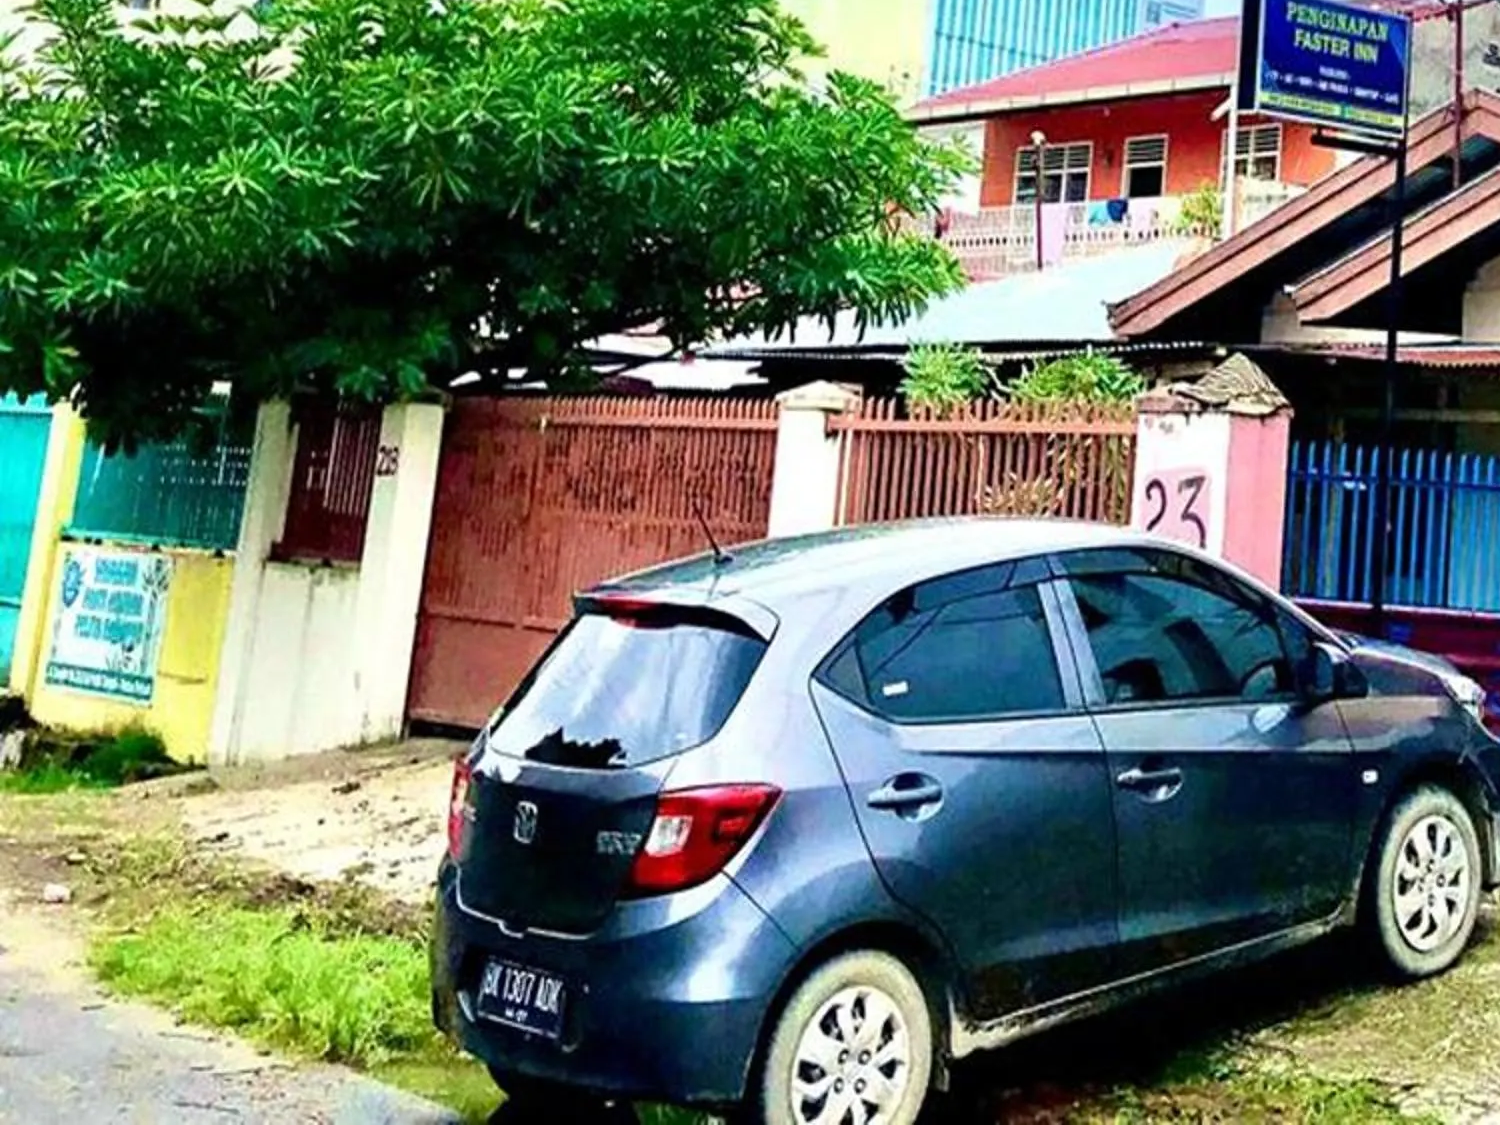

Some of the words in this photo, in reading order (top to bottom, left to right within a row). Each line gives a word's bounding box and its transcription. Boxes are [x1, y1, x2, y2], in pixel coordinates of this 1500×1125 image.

[1286, 0, 1389, 43] PENGINAPAN
[1294, 28, 1351, 59] FASTER
[1353, 41, 1379, 66] INN
